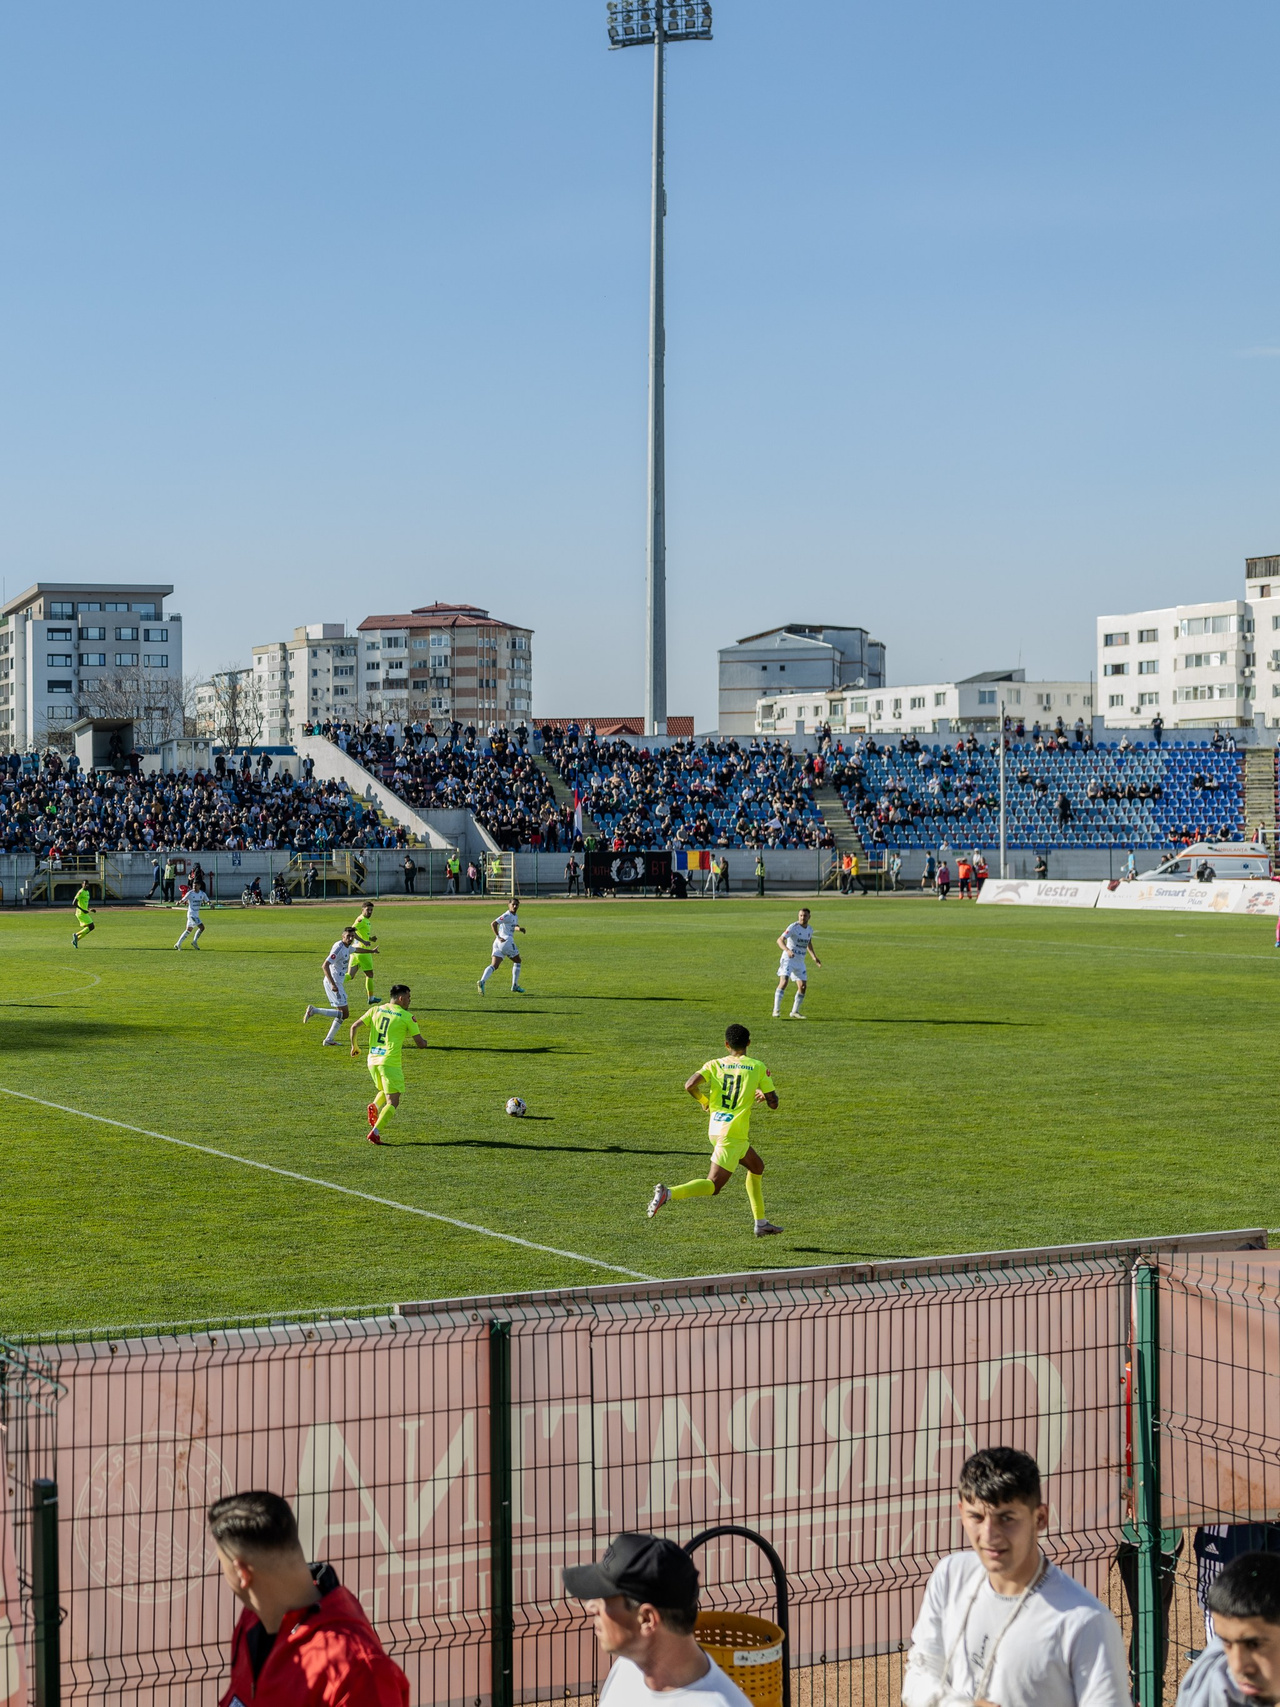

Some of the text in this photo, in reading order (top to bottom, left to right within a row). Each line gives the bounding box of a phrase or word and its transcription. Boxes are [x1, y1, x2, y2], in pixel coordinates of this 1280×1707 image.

[651, 860, 668, 876] BT
[1036, 883, 1079, 898] Vestra
[1155, 887, 1187, 898] Smart
[1188, 888, 1208, 898] Eco
[377, 1016, 391, 1045] 2
[722, 1073, 742, 1110] 21
